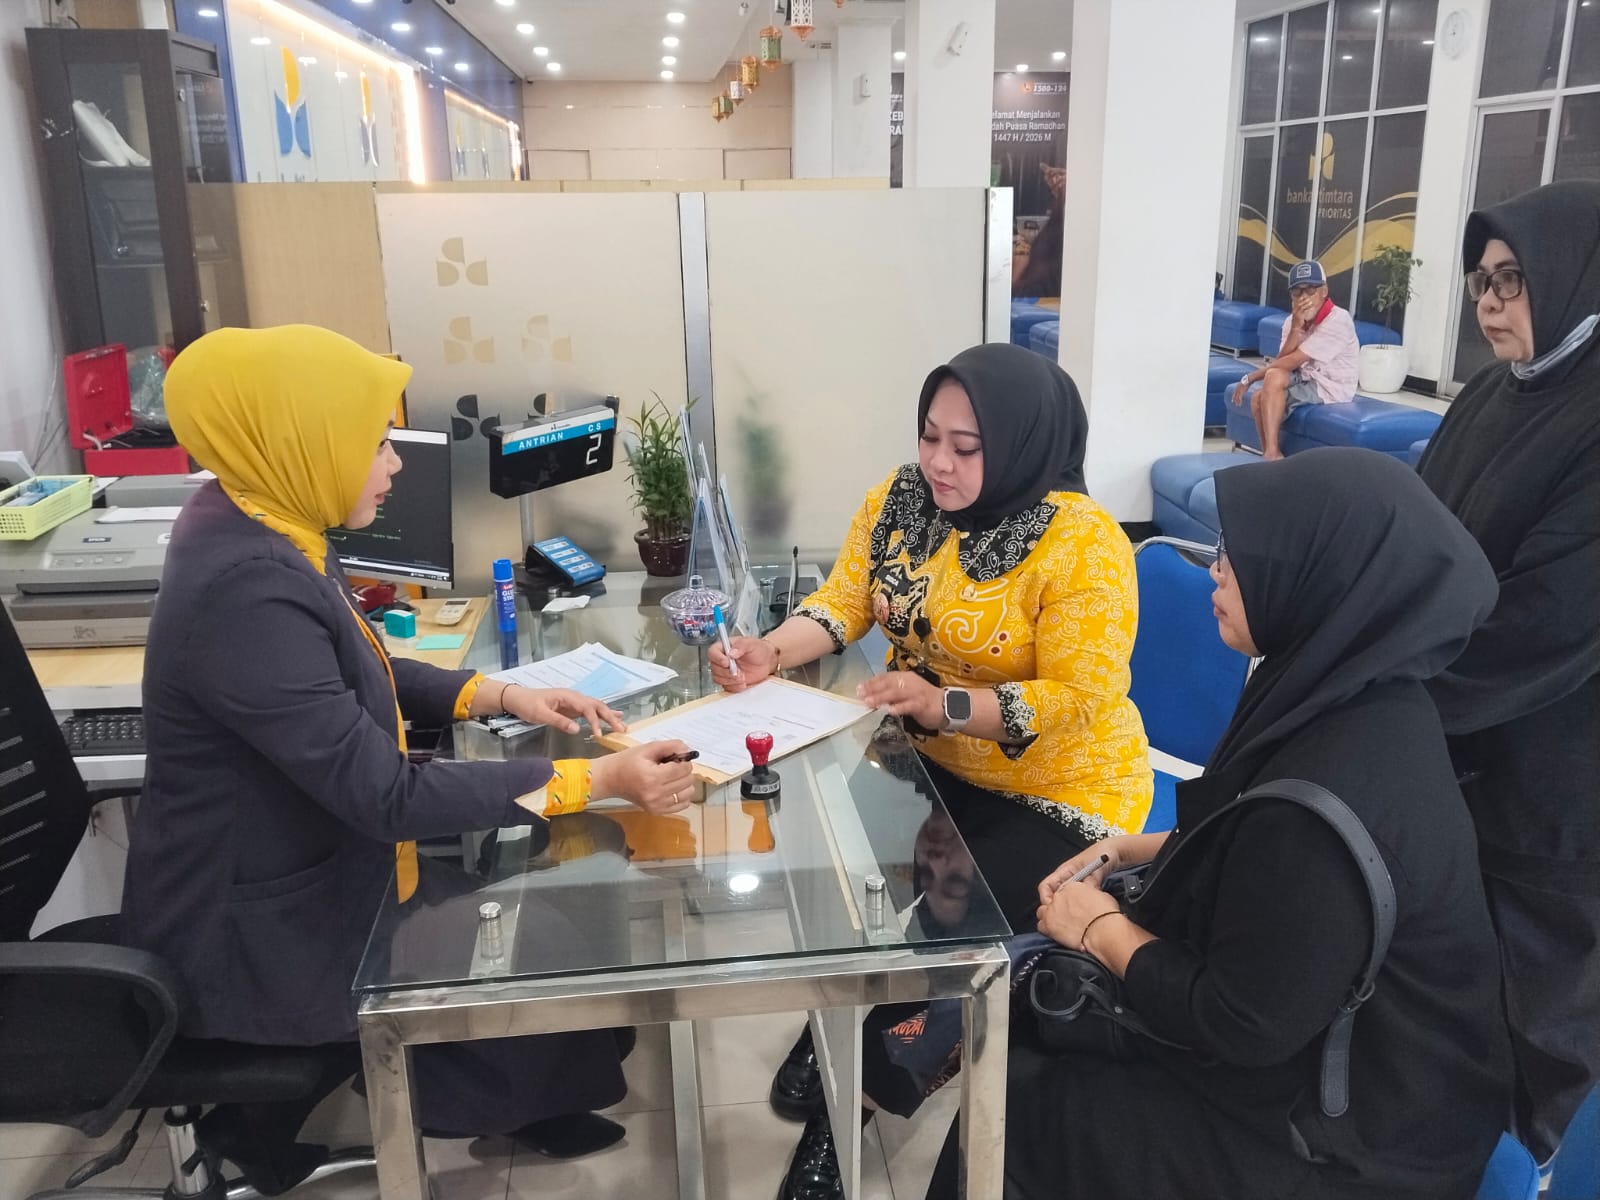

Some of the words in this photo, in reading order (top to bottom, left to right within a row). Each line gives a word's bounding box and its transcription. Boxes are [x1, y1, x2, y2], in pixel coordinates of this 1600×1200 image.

[1016, 110, 1061, 121] Menjalankan
[1005, 122, 1028, 131] Puasa
[1028, 121, 1066, 131] Ramadhan
[994, 133, 1011, 142] 1447
[1012, 133, 1019, 142] H
[1025, 133, 1043, 142] 2026
[1044, 133, 1052, 142] M
[1318, 207, 1352, 219] PRIORITAS
[519, 432, 564, 450] ANTRIAN
[586, 433, 602, 465] 2
